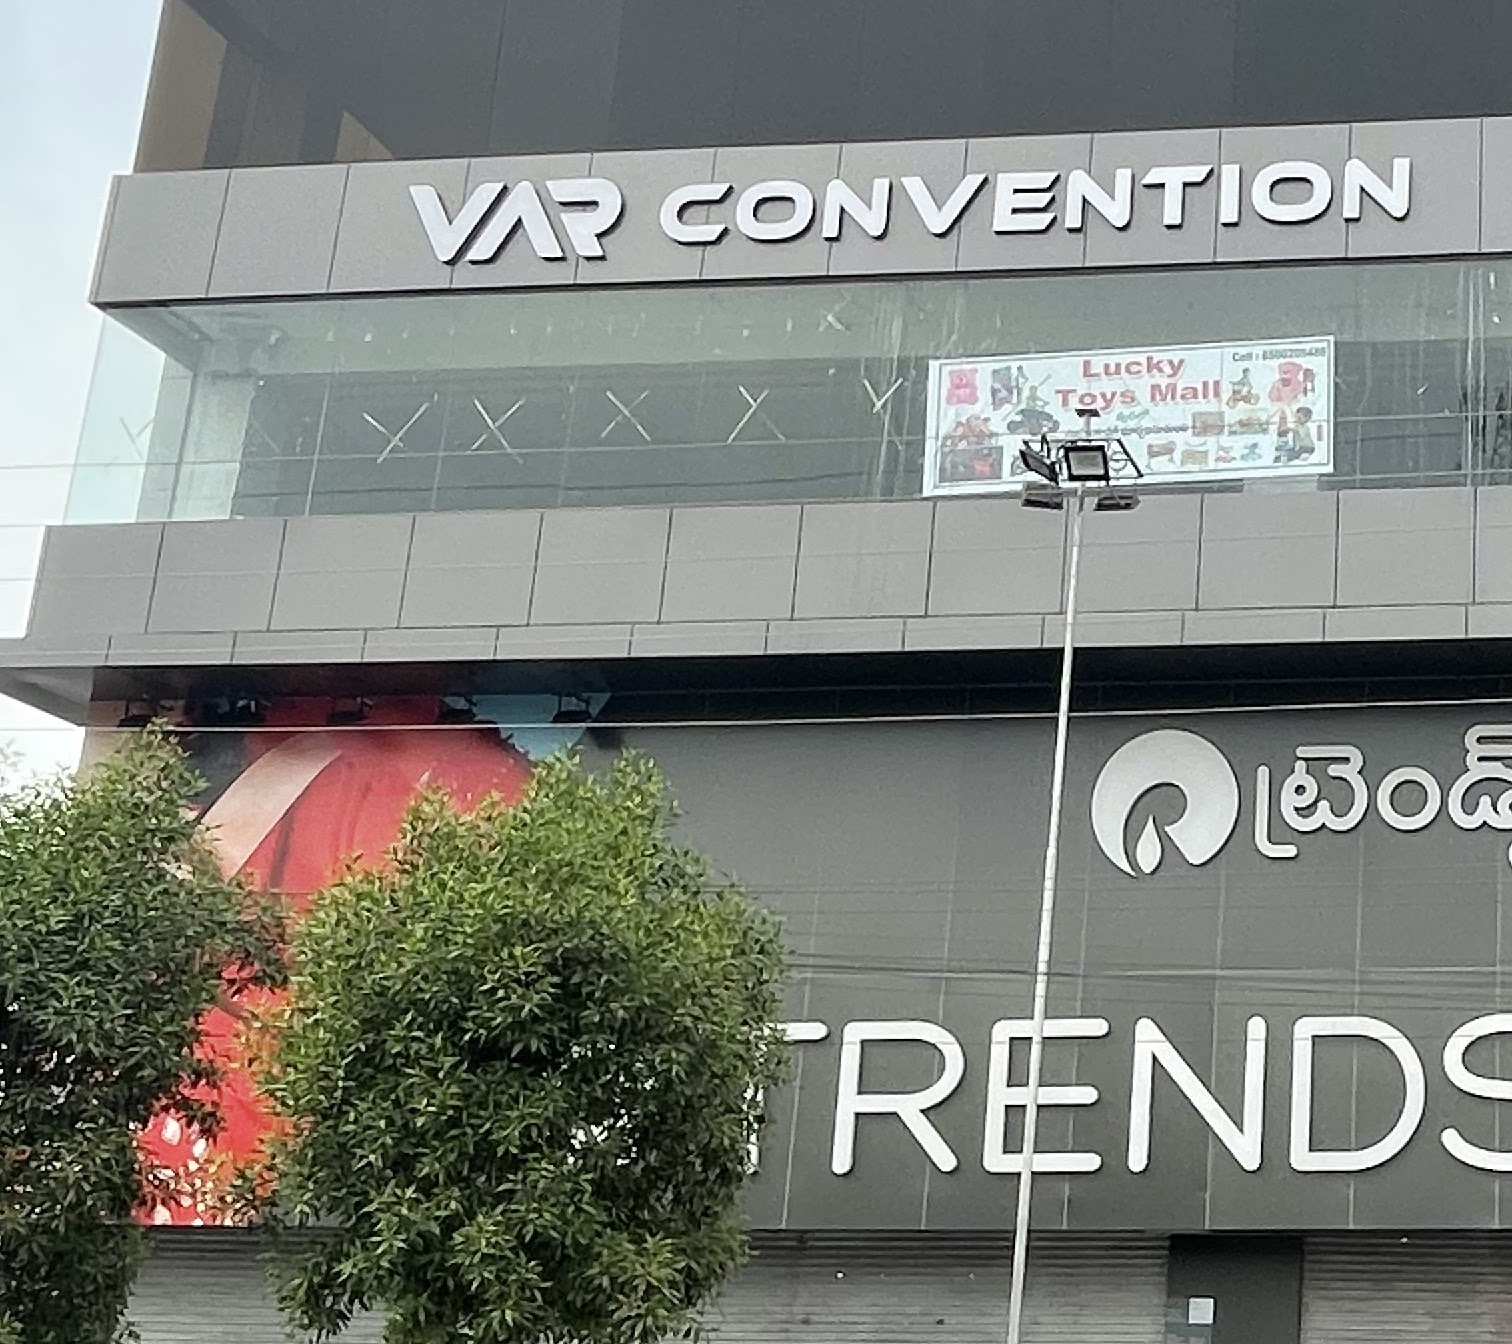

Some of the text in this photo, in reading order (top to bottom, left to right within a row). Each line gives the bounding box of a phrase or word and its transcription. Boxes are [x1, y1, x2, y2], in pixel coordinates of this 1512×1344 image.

[408, 156, 1412, 263] VAR CONVENTION
[1082, 355, 1186, 378] Lucky
[1054, 379, 1221, 412] Toys Mall
